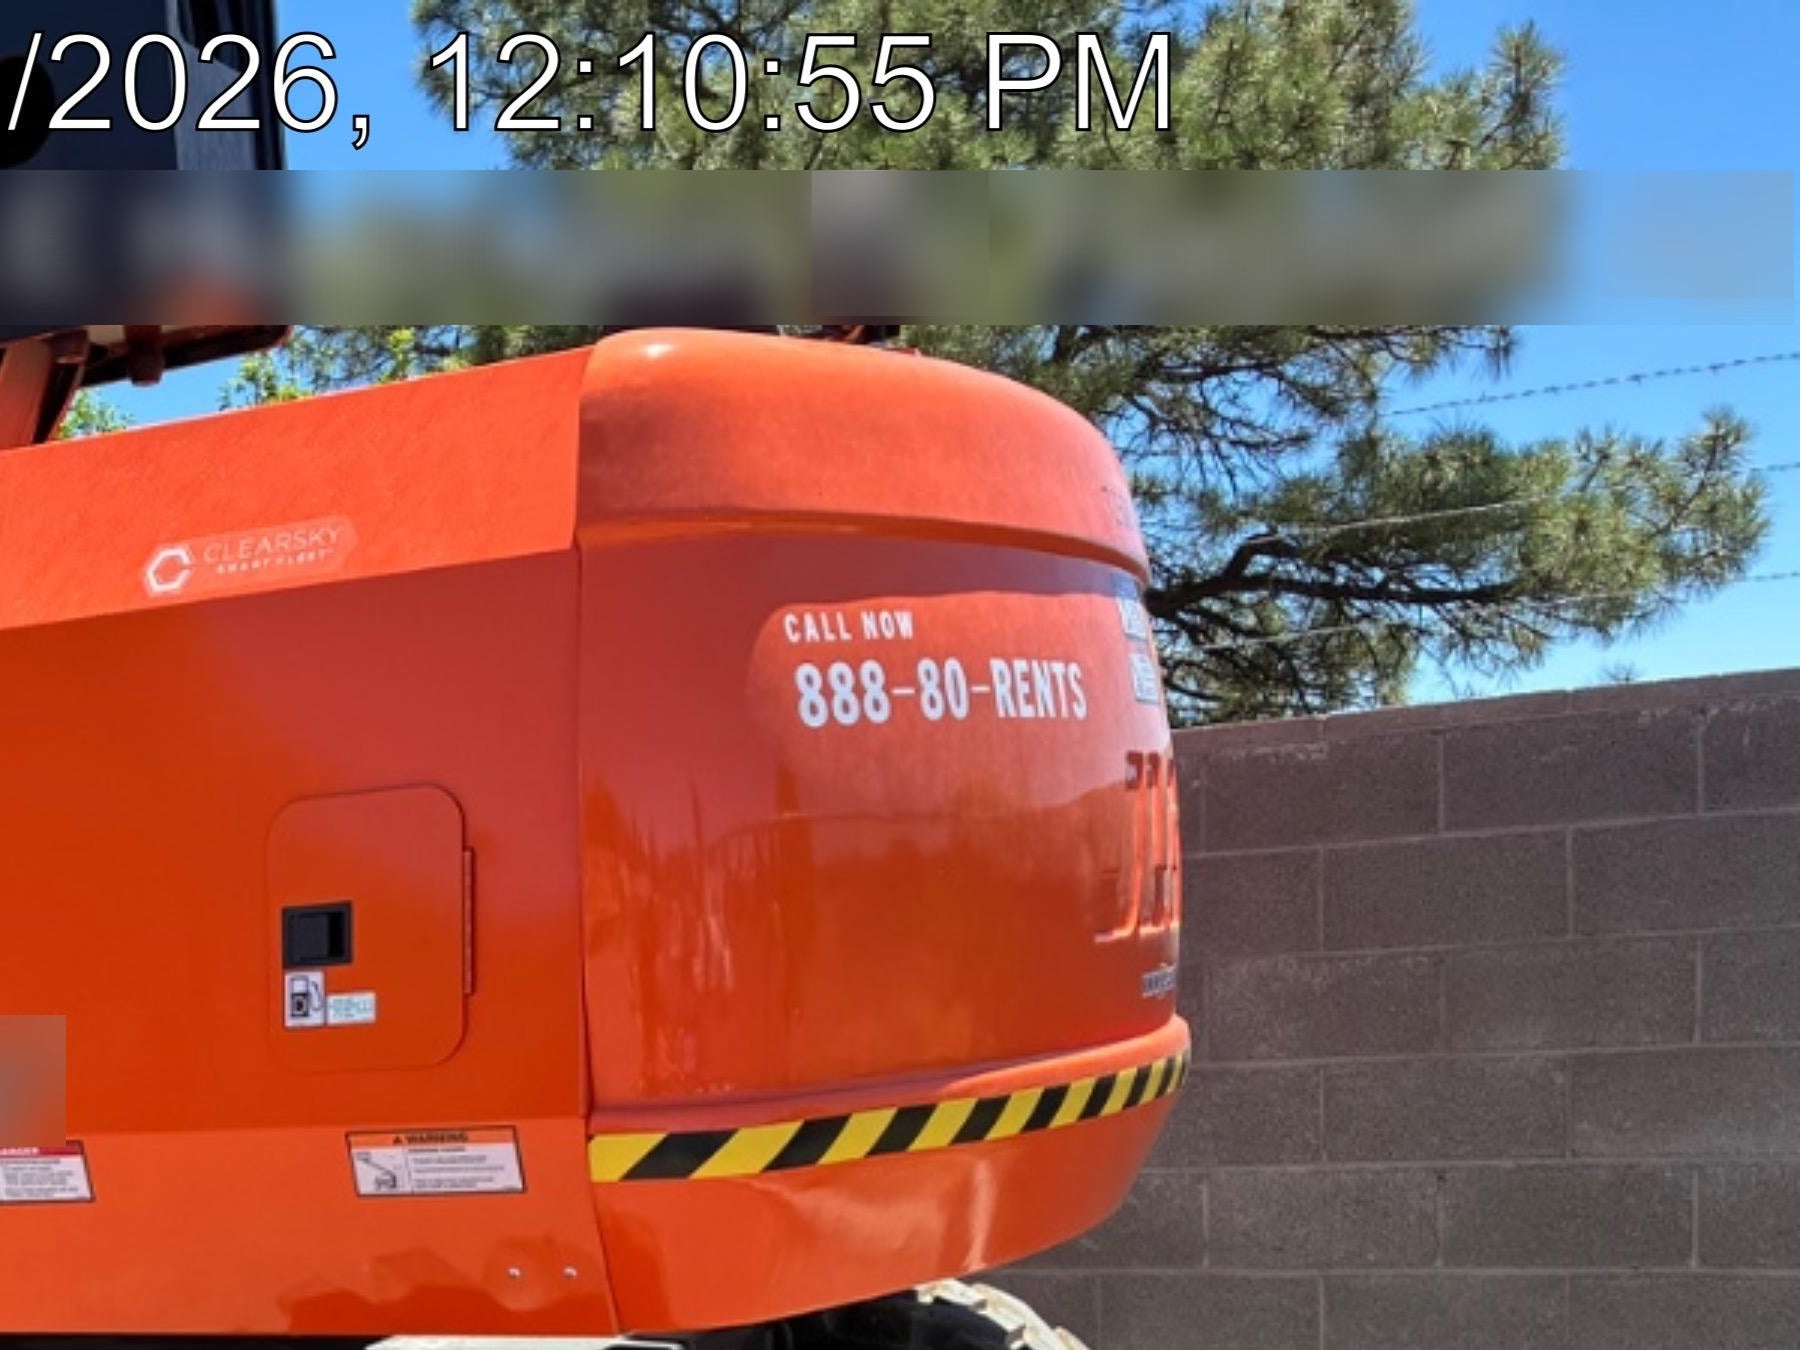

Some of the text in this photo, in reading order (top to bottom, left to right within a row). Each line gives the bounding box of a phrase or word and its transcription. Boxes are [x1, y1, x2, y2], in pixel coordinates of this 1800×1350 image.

[203, 526, 339, 564] CLEARSKY
[784, 611, 914, 643] CALL NOW
[794, 657, 1088, 728] 888-80-RENTS
[407, 1132, 469, 1145] WARNING
